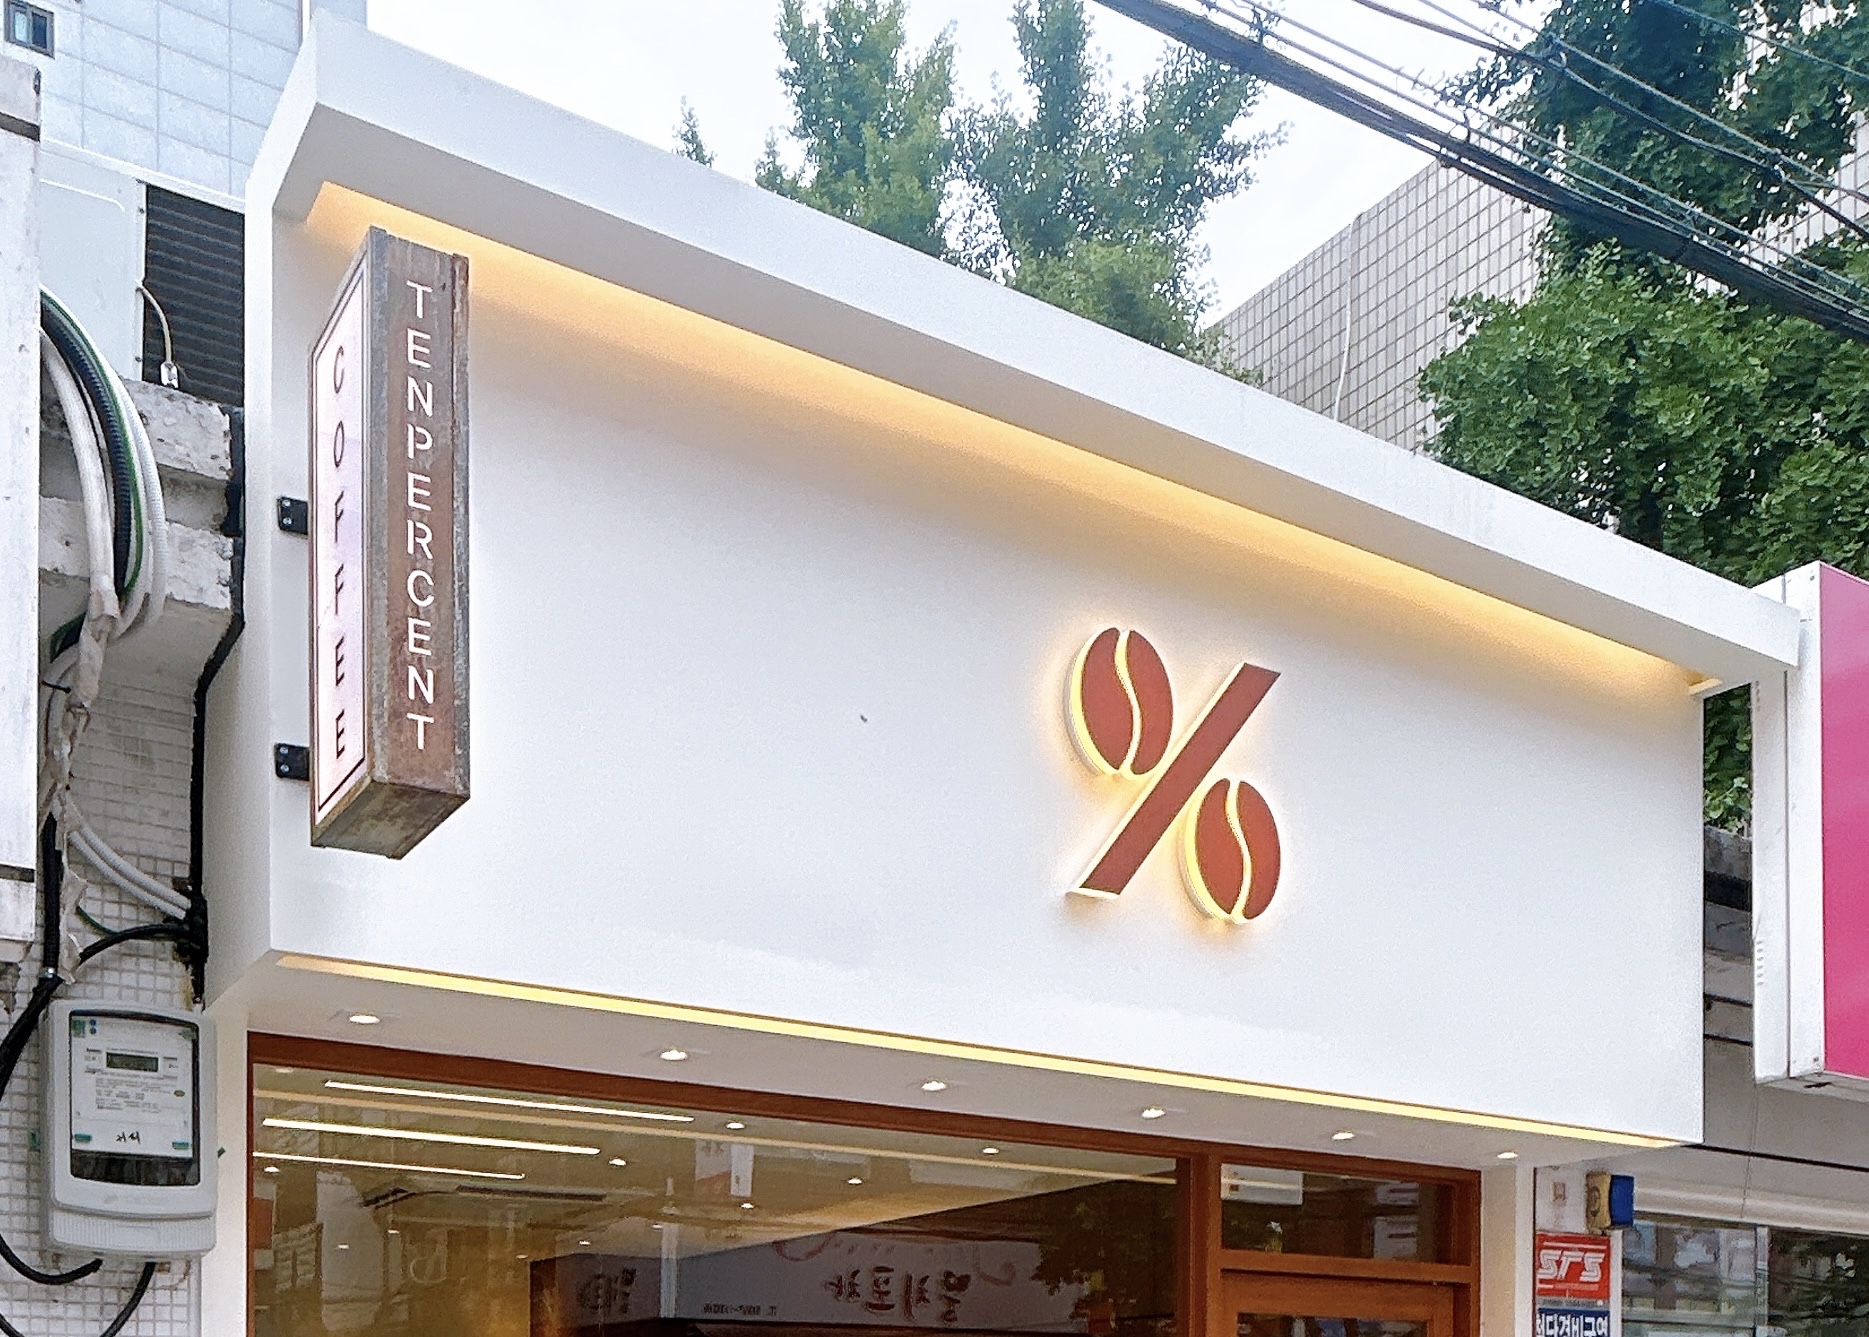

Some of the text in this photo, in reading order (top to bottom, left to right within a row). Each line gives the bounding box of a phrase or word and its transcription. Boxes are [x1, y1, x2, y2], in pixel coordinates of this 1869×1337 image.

[333, 345, 346, 760] COFFEE
[406, 279, 435, 751] TENPERCENT
[1537, 1249, 1605, 1282] STS
